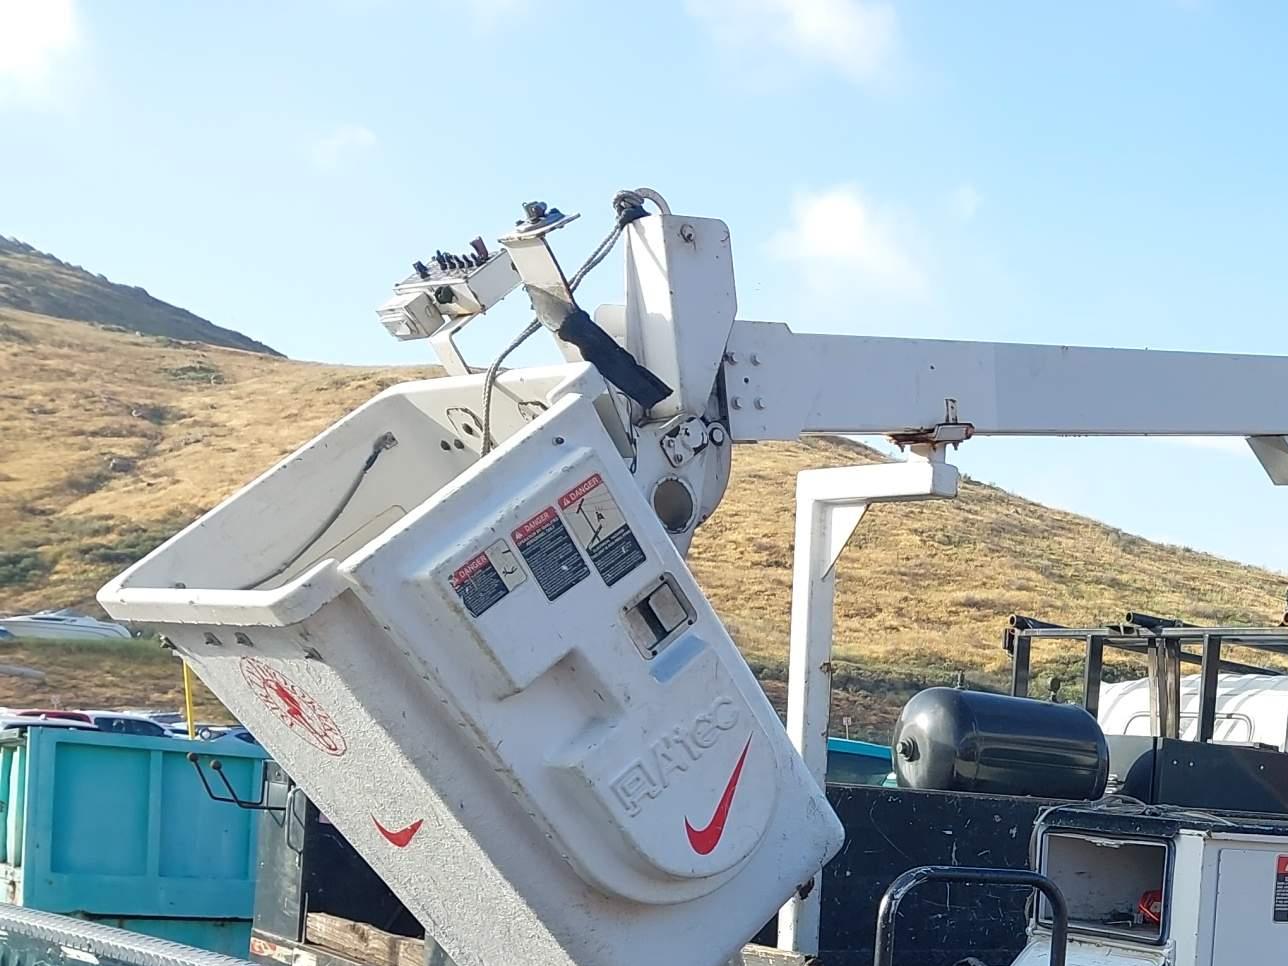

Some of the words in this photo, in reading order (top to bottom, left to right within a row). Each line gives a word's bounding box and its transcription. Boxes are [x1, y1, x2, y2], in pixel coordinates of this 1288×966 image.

[569, 476, 599, 499] DANGER
[523, 511, 550, 532] DANGER
[459, 555, 487, 578] DANGER
